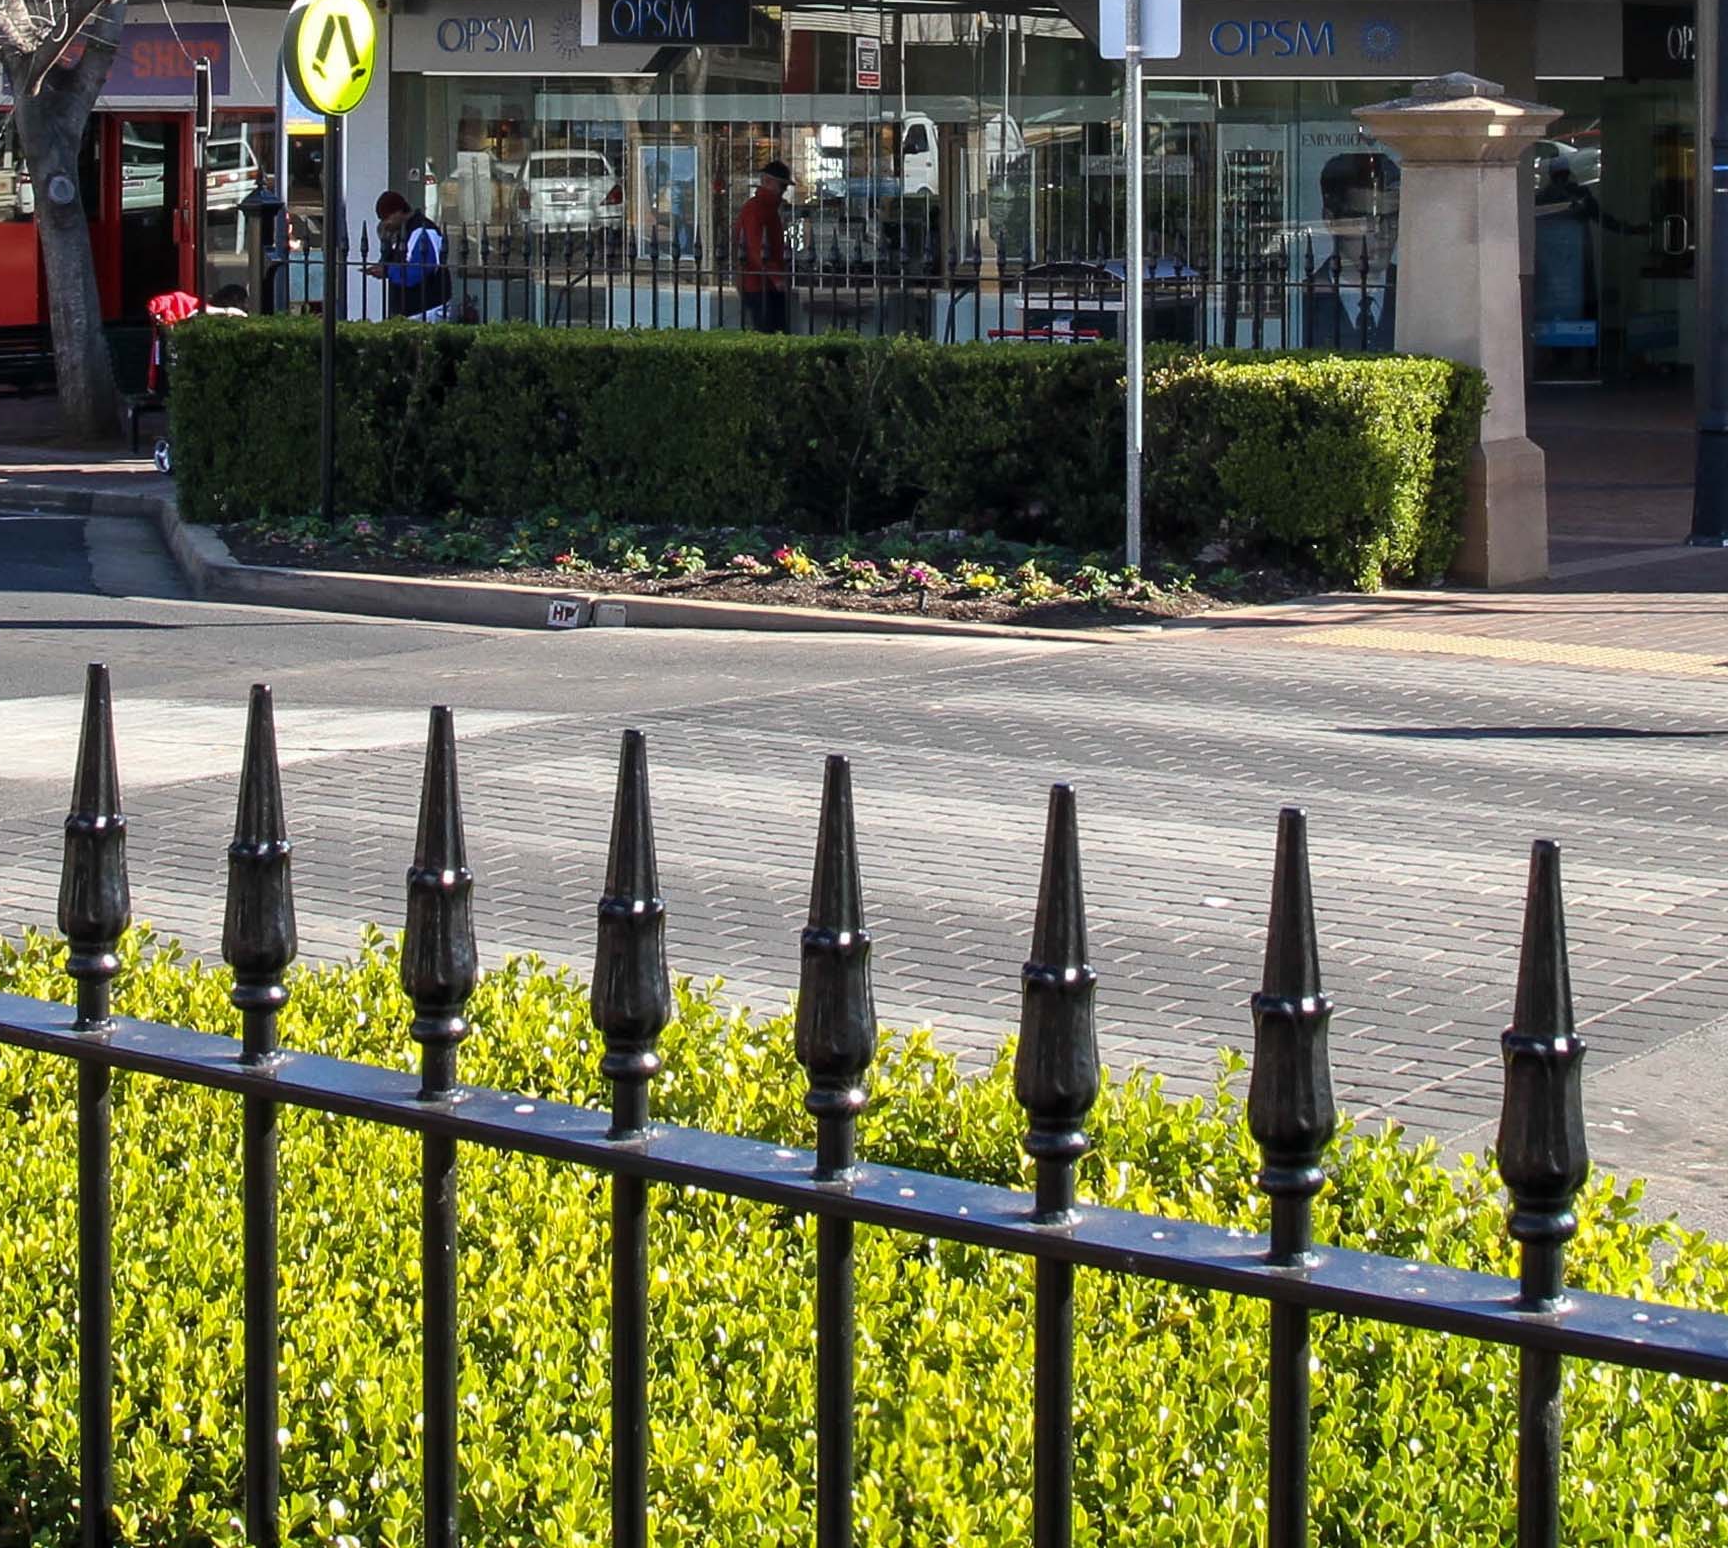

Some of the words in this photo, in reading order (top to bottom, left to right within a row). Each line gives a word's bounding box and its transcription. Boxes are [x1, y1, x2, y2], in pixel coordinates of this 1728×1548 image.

[437, 17, 536, 53] OPSM
[1210, 20, 1336, 57] OPSM
[553, 604, 579, 621] HP
